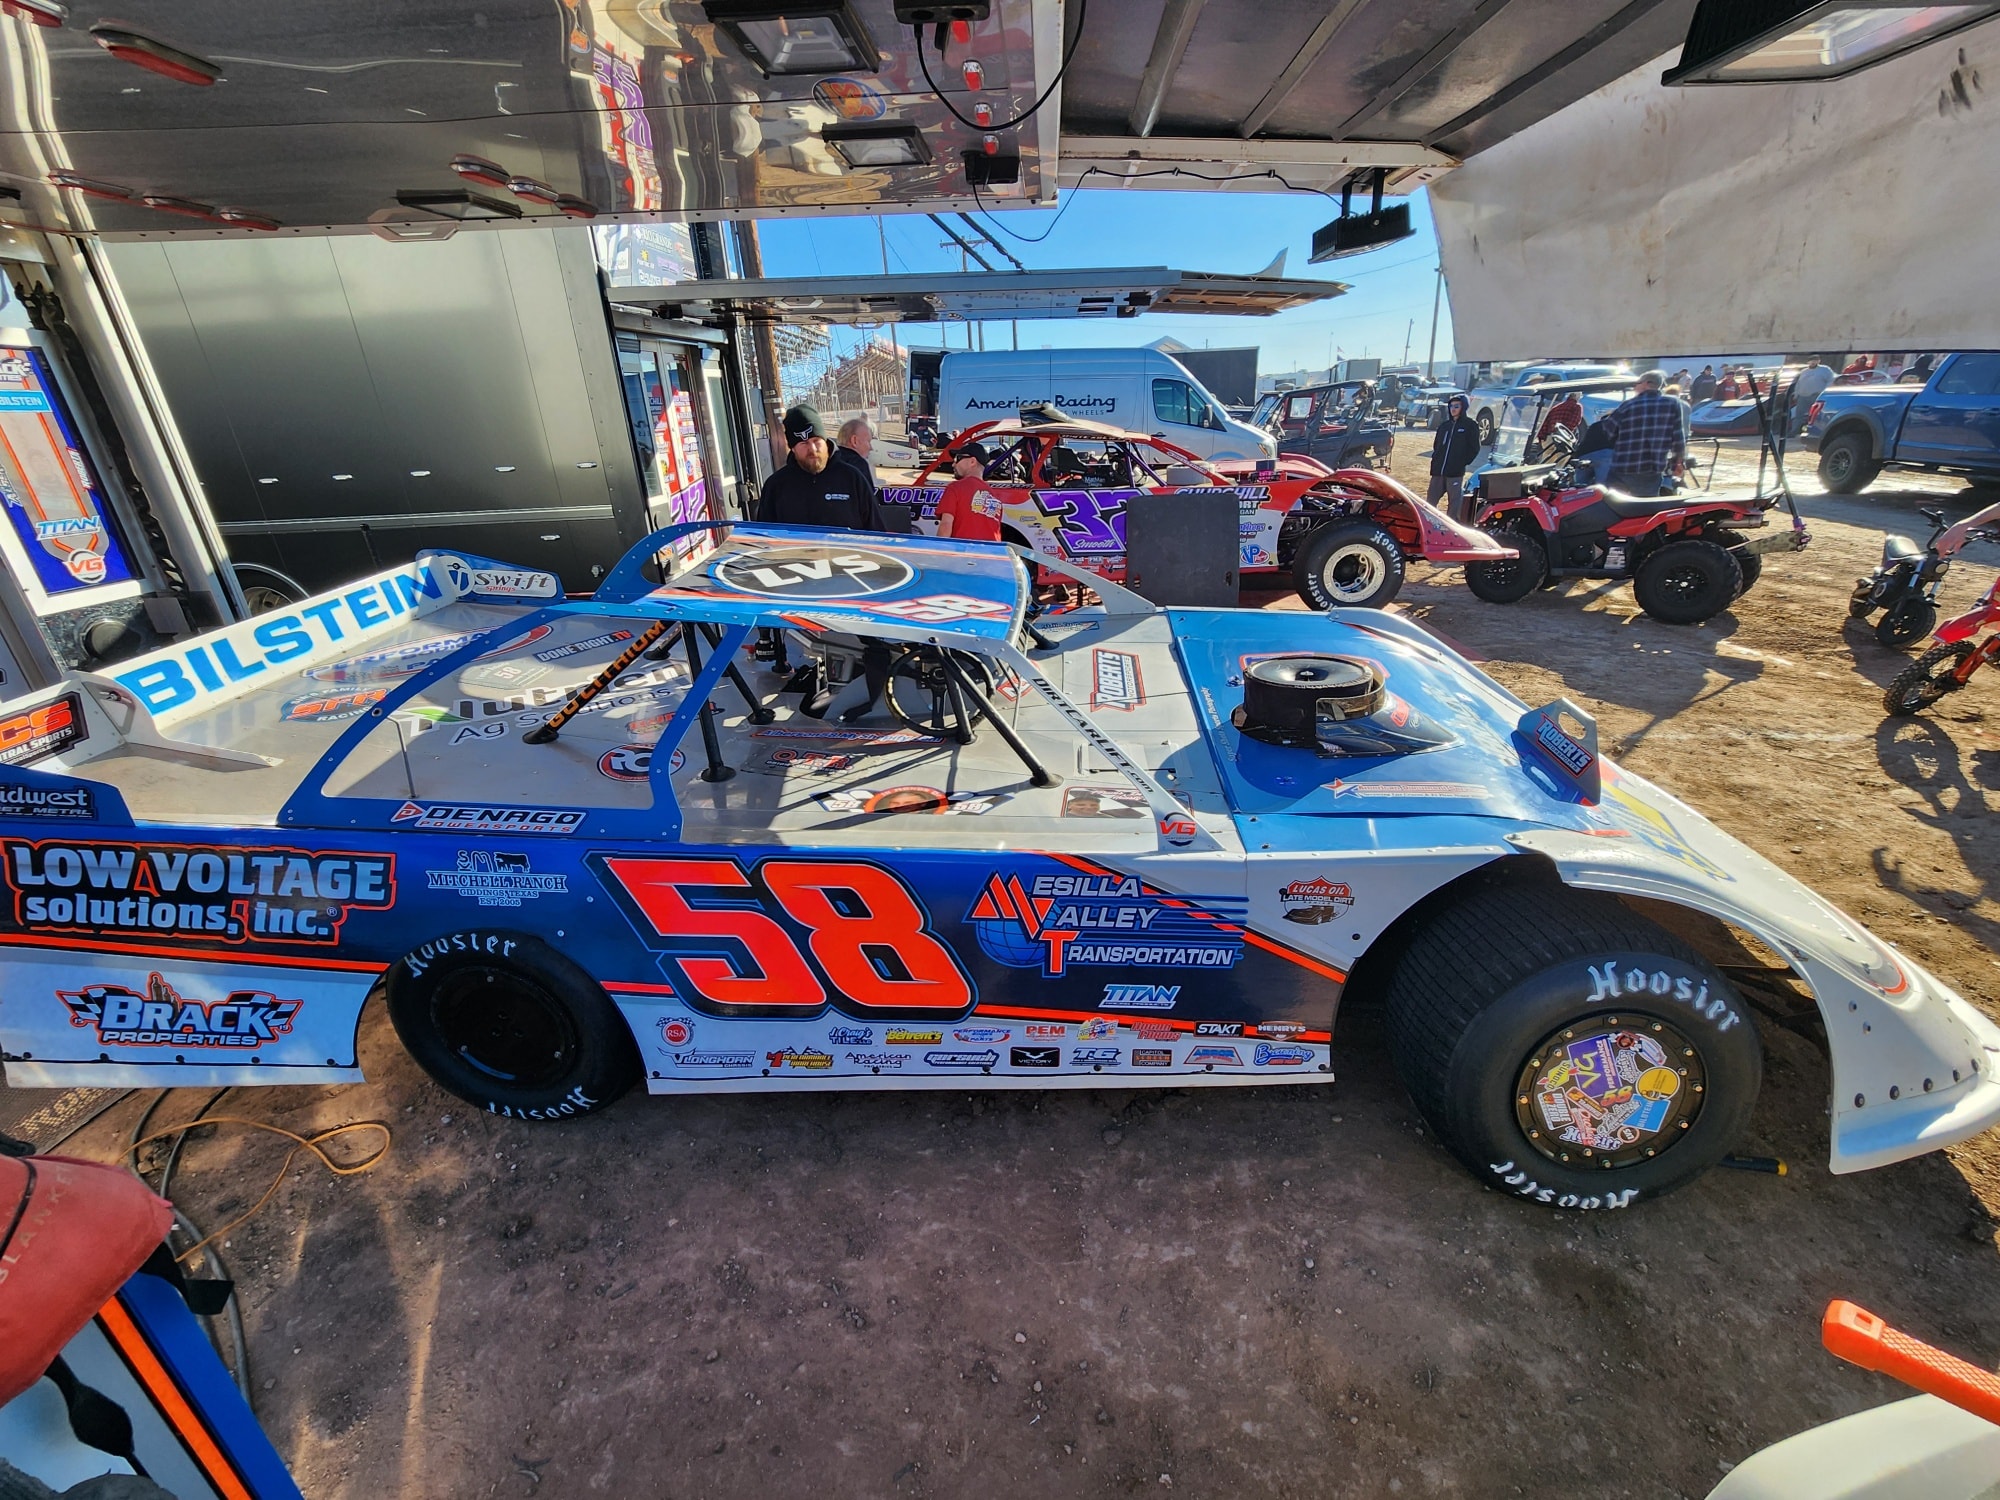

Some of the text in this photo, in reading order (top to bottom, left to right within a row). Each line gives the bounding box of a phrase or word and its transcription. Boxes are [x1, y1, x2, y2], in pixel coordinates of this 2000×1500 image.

[1055, 395, 1116, 413] Racing
[38, 518, 98, 535] TITAN
[1073, 539, 1115, 549] Smooth
[68, 556, 104, 573] VG
[475, 573, 549, 589] Swift
[115, 566, 443, 716] BILSTEIN
[537, 629, 632, 663] DONE RIGHT.TV
[30, 727, 73, 748] SPORTS
[452, 722, 505, 745] Ag
[1537, 719, 1592, 769] ROBERTS
[425, 807, 583, 824] DENAGO
[419, 820, 573, 833] POWERSPORTS
[1159, 821, 1197, 836] VG
[12, 846, 386, 901] LOW VOLTAGE
[429, 873, 567, 890] MITCHELL RANCH
[509, 890, 539, 898] TEXAS
[1293, 885, 1345, 895] LUCAS OIL
[480, 897, 497, 905] EST
[1304, 894, 1333, 902] MODEL
[1333, 896, 1353, 904] DIRT
[26, 895, 240, 935] solutions,
[601, 858, 971, 1008] 58
[403, 933, 518, 979] Hoosier
[1040, 931, 1233, 973] TRANSPORTATION
[1105, 985, 1180, 1002] TITAN
[1587, 961, 1740, 1032] Hoosier
[101, 995, 272, 1039] BRACK
[667, 1029, 686, 1038] RSA
[887, 1029, 943, 1041] Behrent's
[1026, 1026, 1066, 1035] PEM
[1197, 1024, 1242, 1034] STAKT
[102, 1030, 258, 1046] PROPERTIES
[831, 1037, 857, 1045] TILE
[683, 1055, 754, 1064] LONGHORN
[854, 1058, 902, 1068] Racing
[1548, 1061, 1572, 1091] SUNOCO
[486, 1085, 599, 1120] Hoosier
[1553, 1093, 1573, 1122] DOUBLE
[1548, 1104, 1561, 1122] ZERO
[1489, 1160, 1640, 1210] Hoosier
